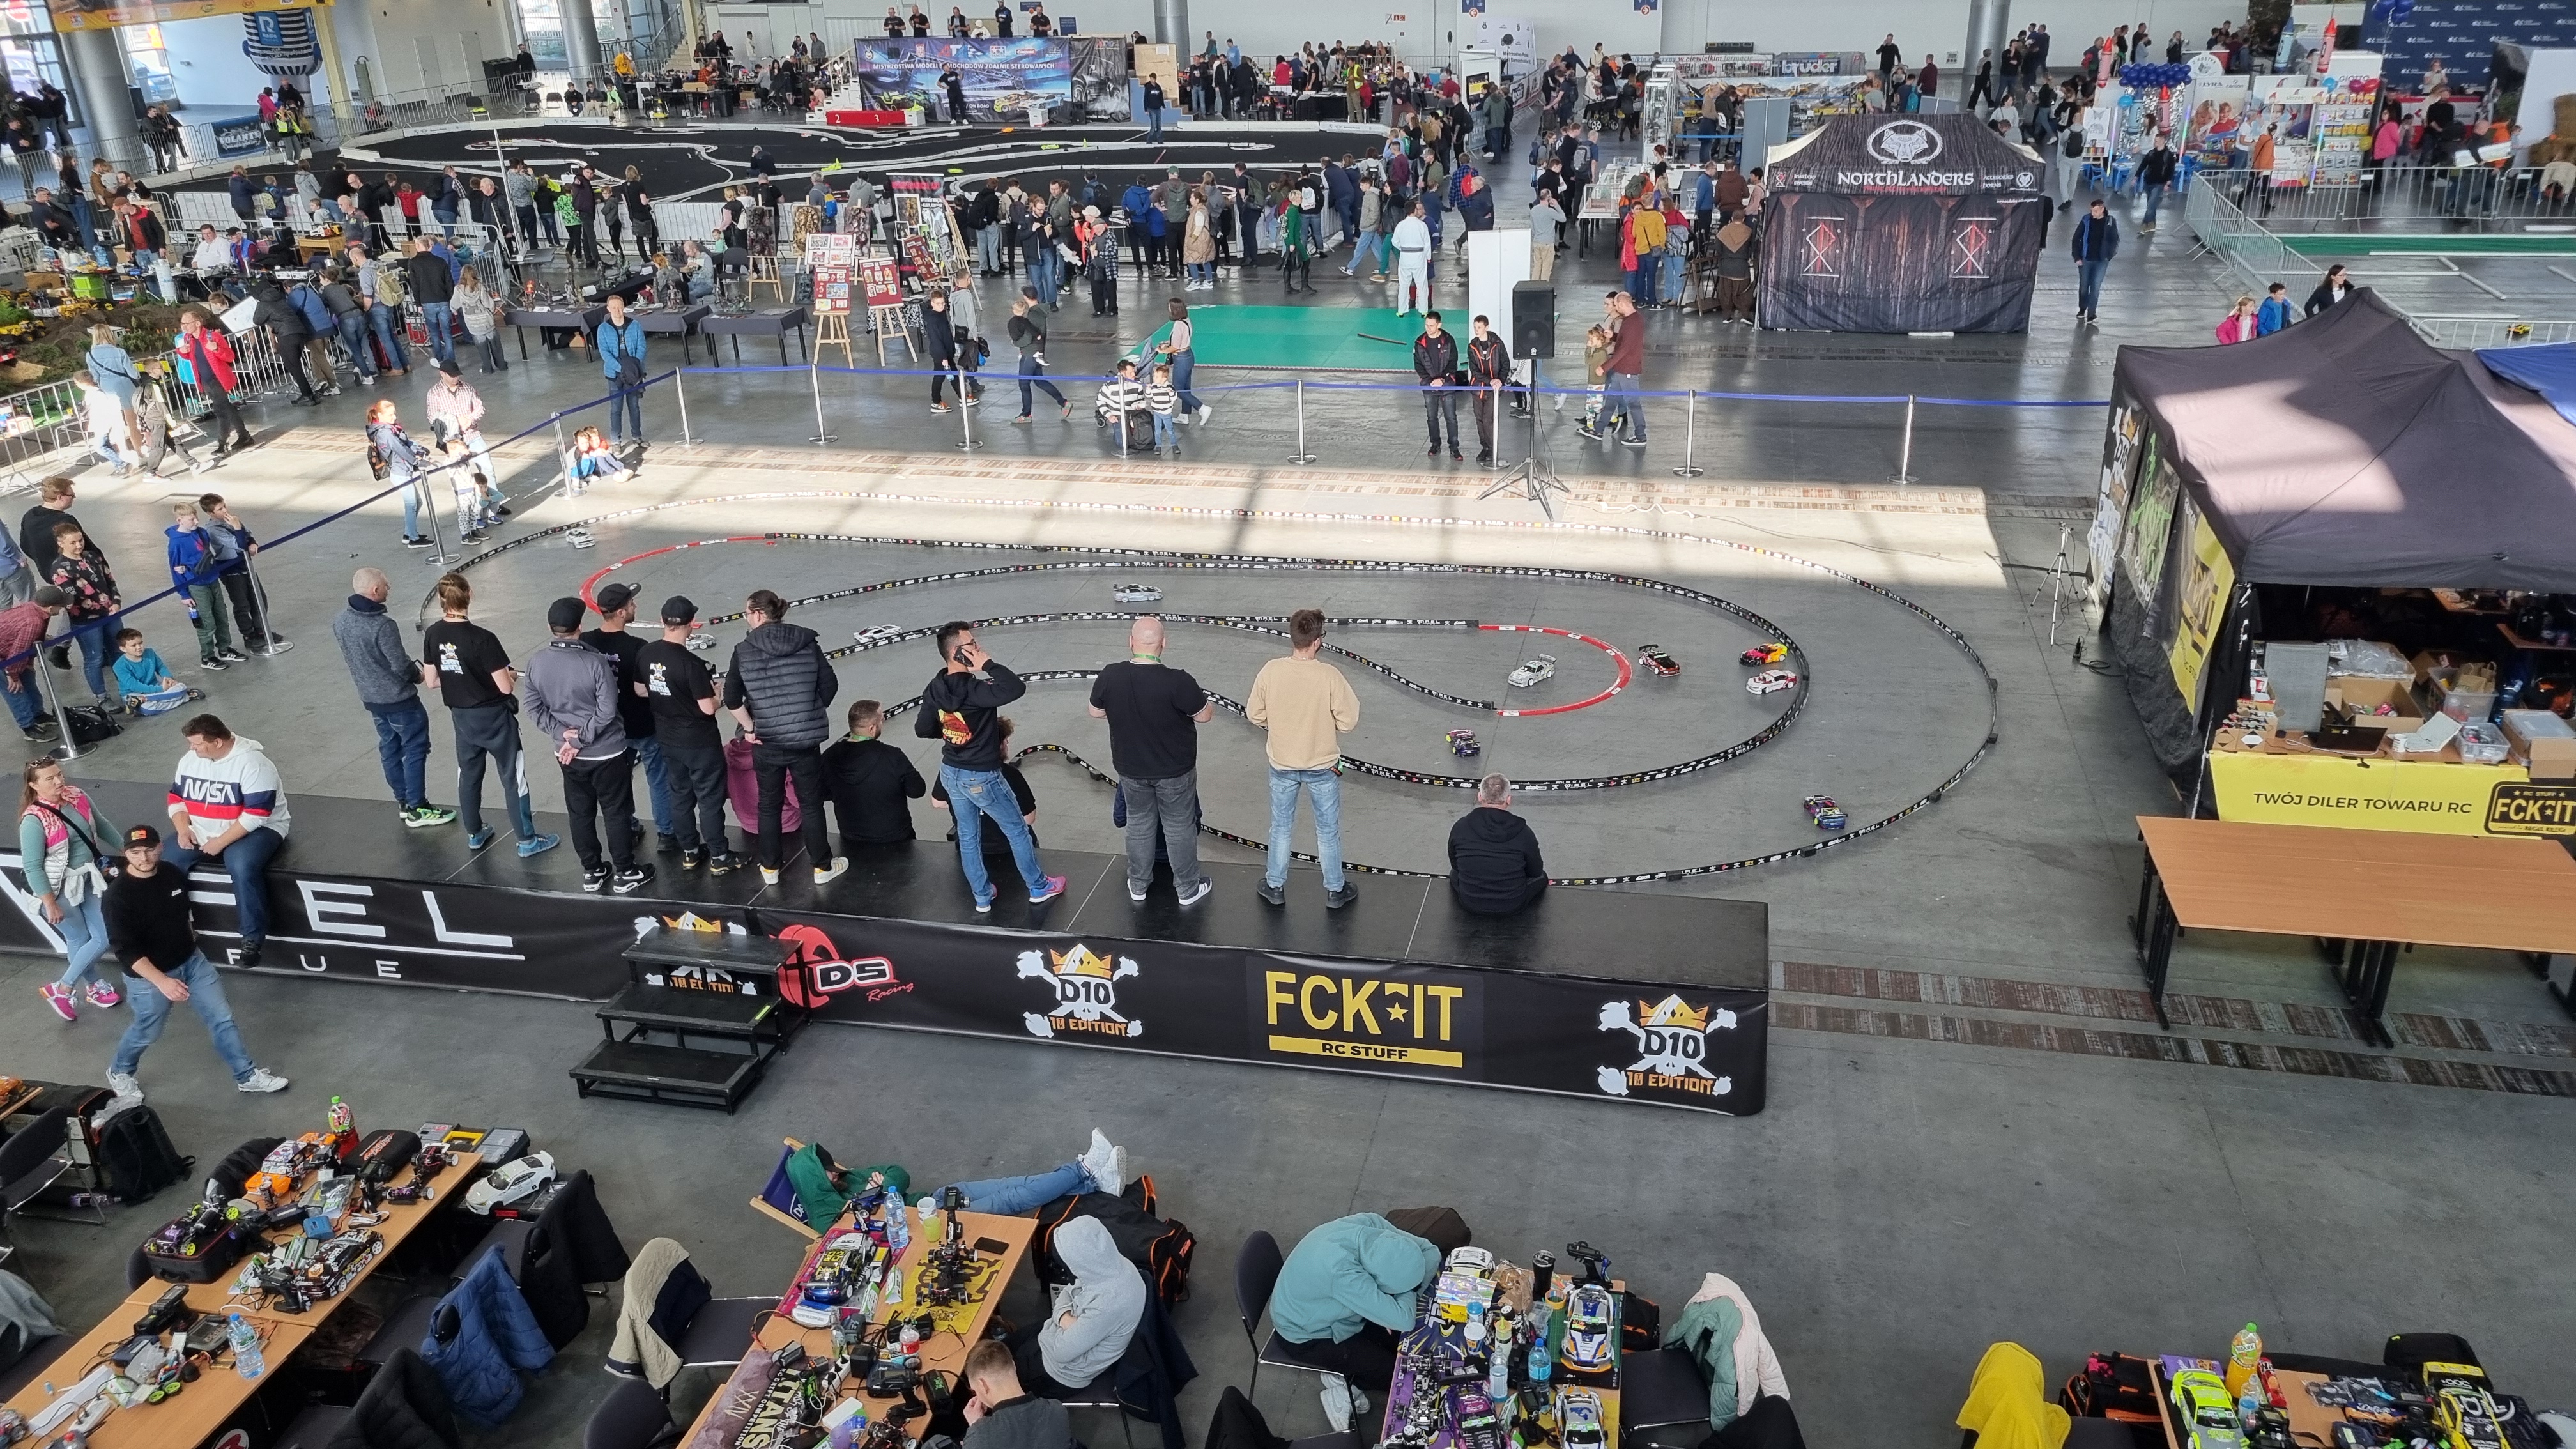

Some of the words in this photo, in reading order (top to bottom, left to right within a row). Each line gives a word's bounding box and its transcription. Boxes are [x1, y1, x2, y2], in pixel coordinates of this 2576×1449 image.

[835, 114, 841, 125] 2
[183, 778, 236, 804] NASA
[2253, 791, 2303, 806] TWÓJ
[2307, 795, 2359, 809] DILER
[2363, 798, 2442, 813] TOWARU
[2447, 802, 2472, 814] RC
[866, 981, 914, 1002] Racing
[1060, 975, 1112, 1004] D10
[1069, 1017, 1127, 1038] EDITION
[1321, 1041, 1346, 1056] RC
[1349, 1044, 1409, 1061] STUFF
[1644, 1030, 1701, 1061] D10
[1648, 1073, 1713, 1095] EDITION
[765, 1377, 780, 1398] DRIFT
[734, 1399, 767, 1446] COMPETITION
